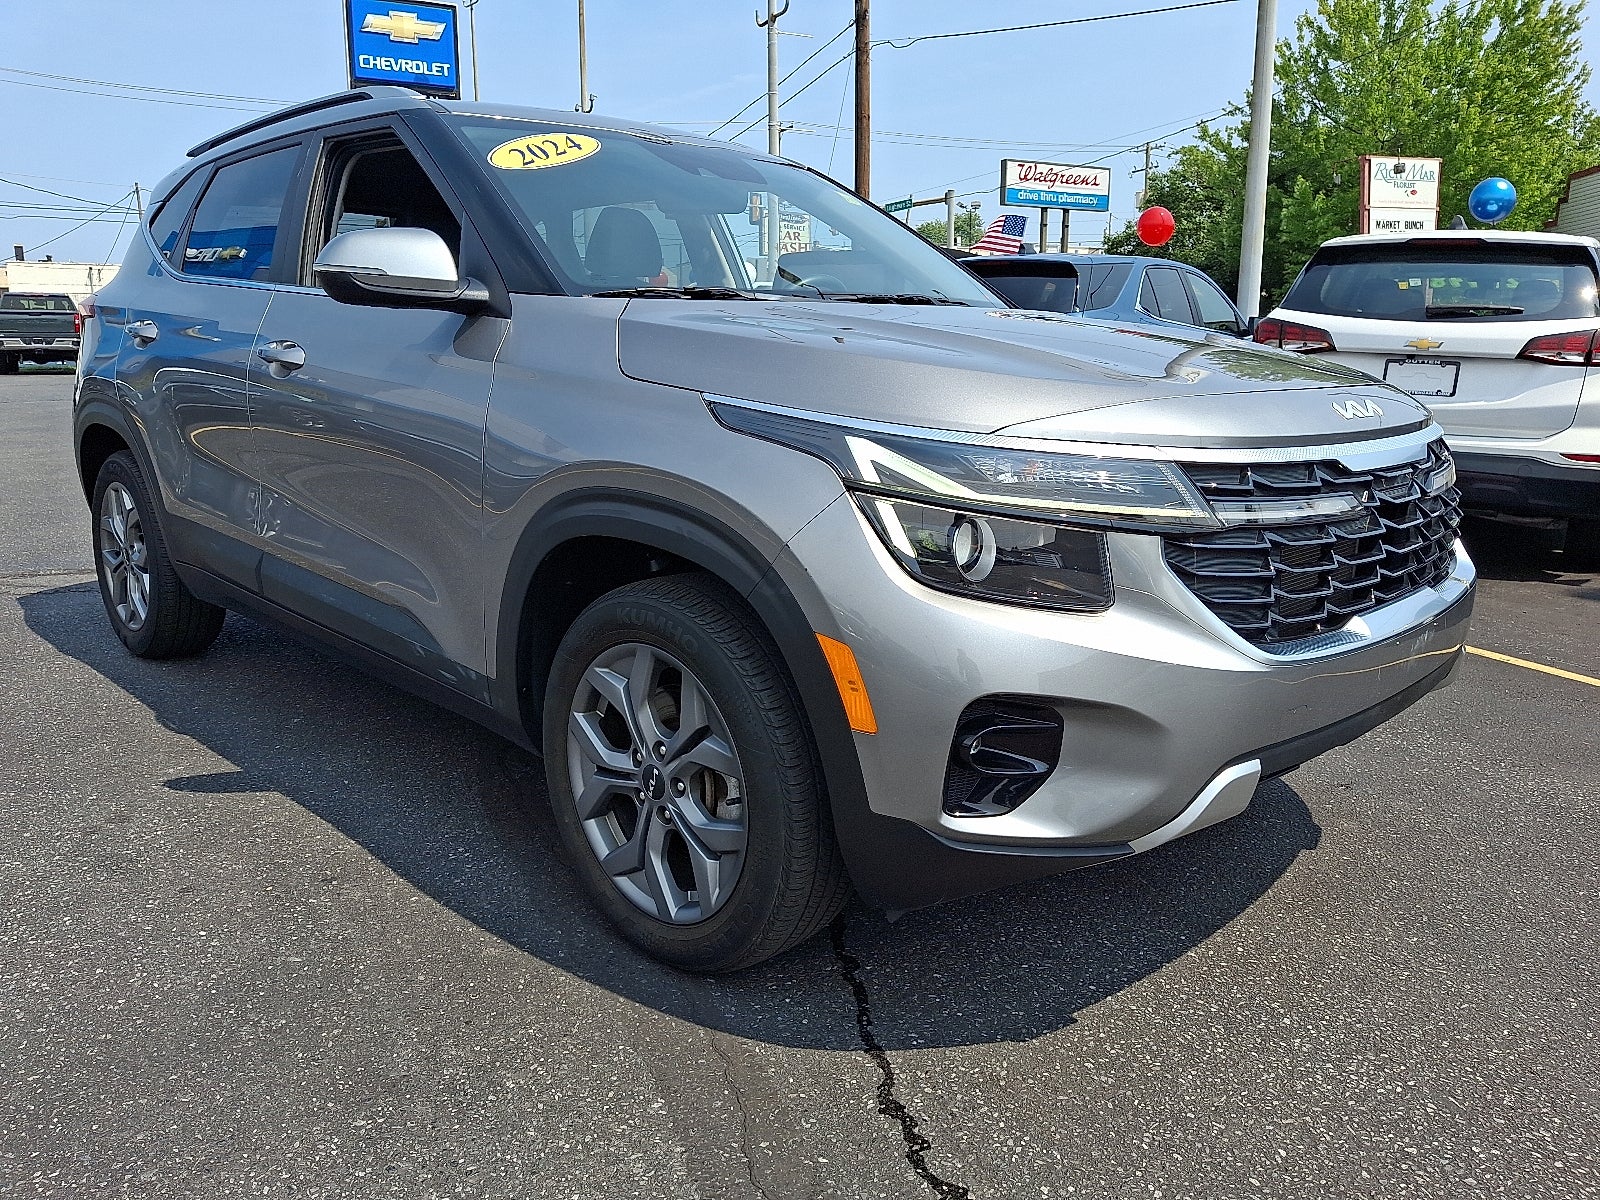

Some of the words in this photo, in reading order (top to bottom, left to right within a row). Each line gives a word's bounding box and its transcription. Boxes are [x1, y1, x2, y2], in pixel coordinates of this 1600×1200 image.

[358, 54, 450, 77] CHEVROLET
[508, 136, 582, 166] 2024
[1017, 163, 1100, 189] Walgreens
[1017, 190, 1039, 201] drive
[1040, 191, 1057, 202] thru
[1058, 193, 1098, 207] pharmacy
[1375, 220, 1400, 230] MARKET
[1404, 220, 1424, 230] BUNCH
[780, 230, 802, 242] AR
[779, 242, 809, 253] ASH
[616, 606, 700, 653] KUMHO
